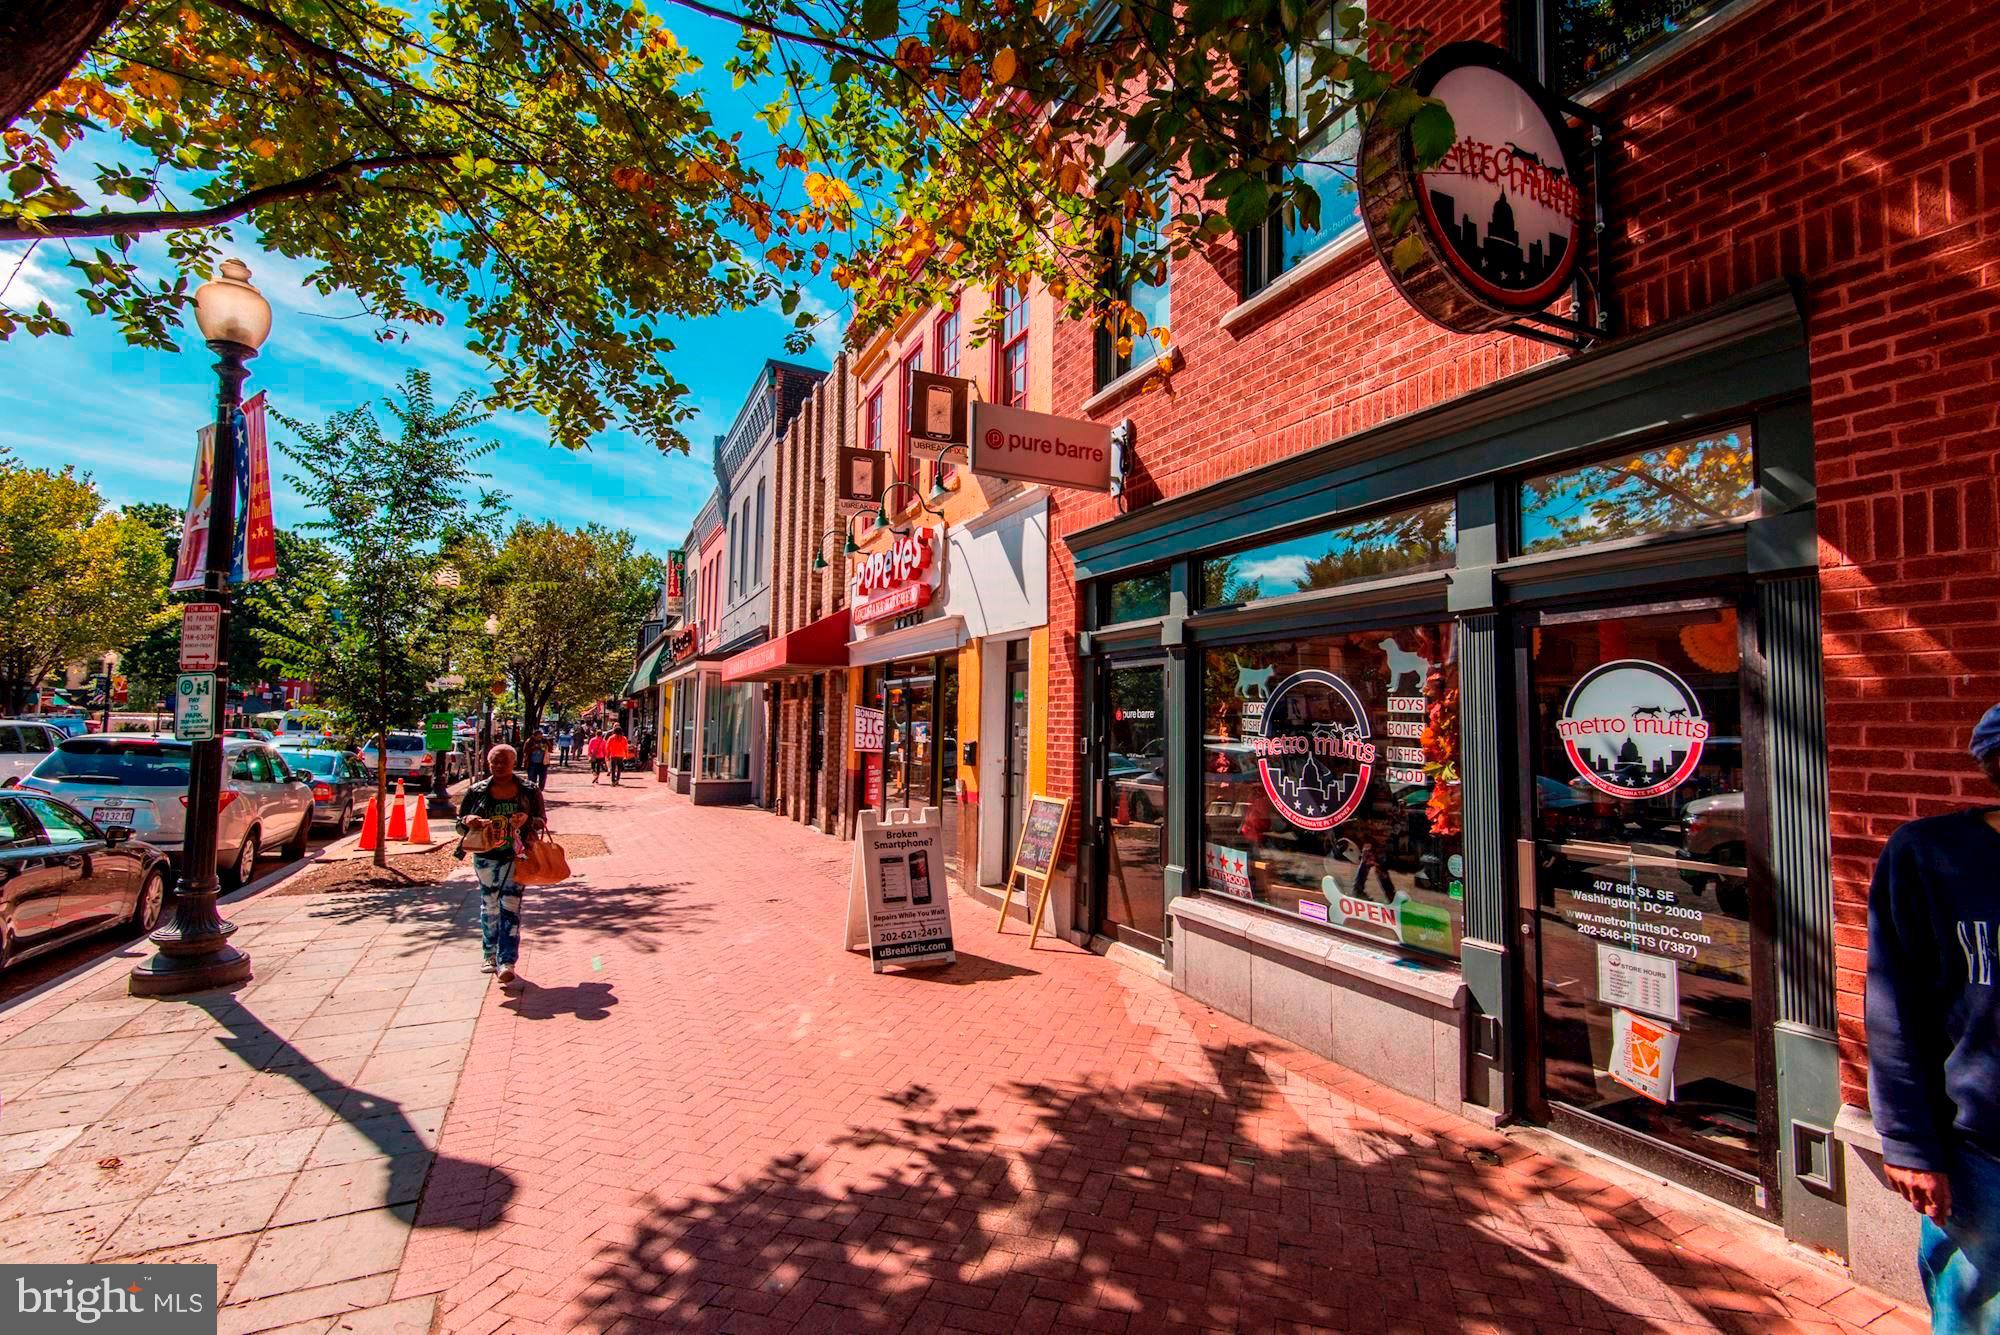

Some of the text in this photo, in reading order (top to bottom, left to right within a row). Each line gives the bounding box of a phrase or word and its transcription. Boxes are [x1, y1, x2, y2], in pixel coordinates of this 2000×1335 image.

[1008, 433, 1103, 462] pure barre
[1243, 703, 1266, 714] TOYS
[1389, 699, 1424, 711] TOYS
[1122, 709, 1155, 720] pure barre
[855, 717, 884, 735] BIG
[1388, 723, 1424, 737] BONES
[1559, 716, 1707, 739] metro mutts
[855, 732, 884, 749] BOX
[1253, 733, 1376, 763] metro mutts
[1387, 748, 1424, 762] DISHES
[1387, 768, 1423, 783] FOOD
[1598, 780, 1608, 790] THE
[1607, 786, 1646, 797] PASSIONATE
[1646, 786, 1659, 796] PET
[1659, 776, 1680, 792] OWNER
[886, 830, 918, 839] Broken
[874, 837, 933, 850] Smartphone?
[1593, 880, 1675, 902] 407 8th St. SE
[1340, 897, 1397, 927] OPEN
[1571, 890, 1703, 921] Washington, DC 20003
[873, 914, 898, 922] Repairs
[897, 911, 916, 919] While
[880, 927, 943, 942] 202-621-2491
[1566, 909, 1711, 944] www.metromuttsDC.com
[1577, 923, 1698, 959] 202-546-PETS (7387)
[879, 942, 947, 957] uBreakiFix.com
[1957, 920, 2000, 985] SE
[1621, 963, 1667, 979] STORE HOURS
